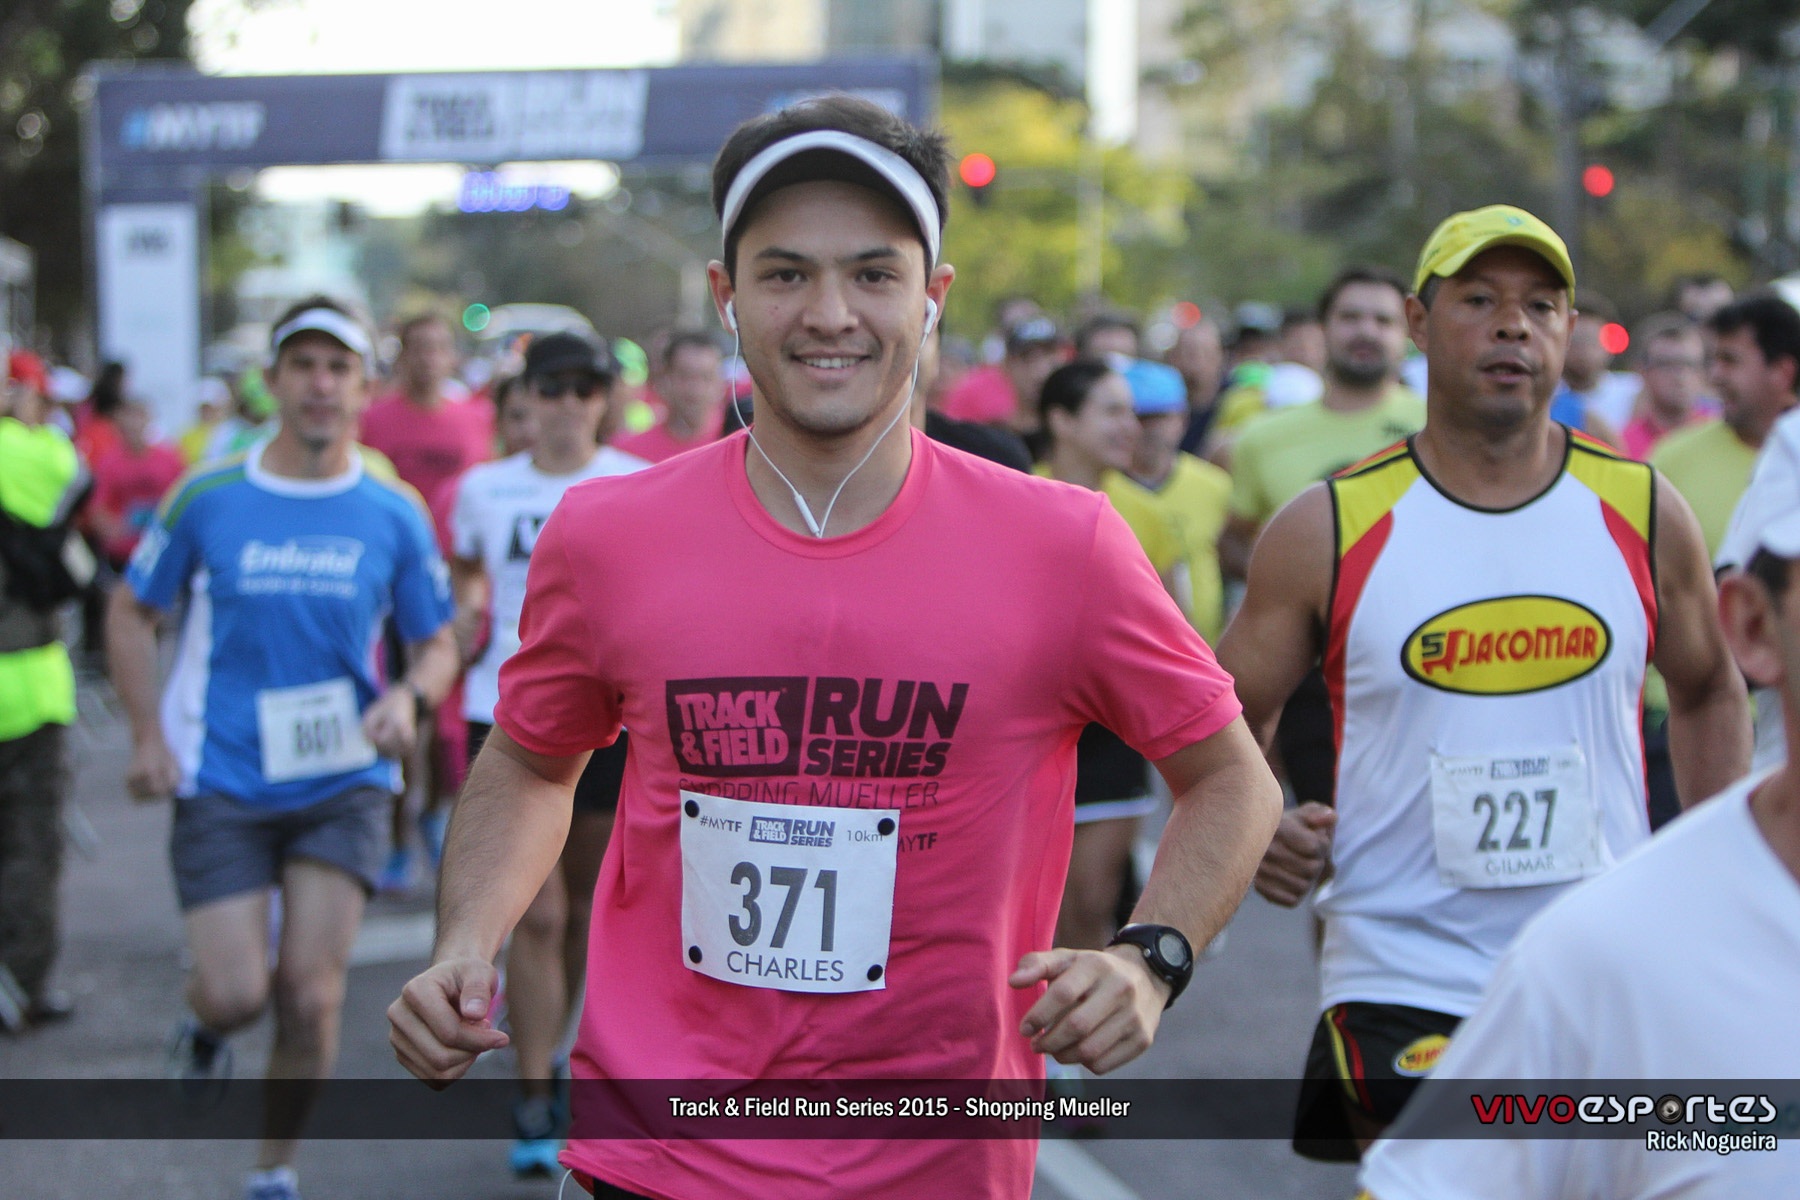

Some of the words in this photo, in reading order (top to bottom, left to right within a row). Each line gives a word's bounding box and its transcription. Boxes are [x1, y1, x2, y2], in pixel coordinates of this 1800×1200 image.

[1460, 626, 1599, 665] JACOMAR
[675, 690, 781, 731] TRACK
[809, 677, 970, 740] RUN
[680, 729, 701, 765] &
[702, 728, 789, 766] FIELD
[803, 738, 953, 778] SERIES
[809, 781, 939, 809] MUELLER
[700, 815, 742, 833] #MYTF
[755, 820, 785, 833] TRACK
[793, 819, 836, 836] RUN
[1473, 788, 1558, 853] 227
[762, 831, 787, 842] FIELD
[790, 836, 833, 847] SERIES
[847, 830, 883, 842] 10km
[899, 832, 938, 853] YTF
[1486, 856, 1556, 877] GILMAR
[728, 861, 838, 952] 371
[726, 950, 844, 982] CHARLES
